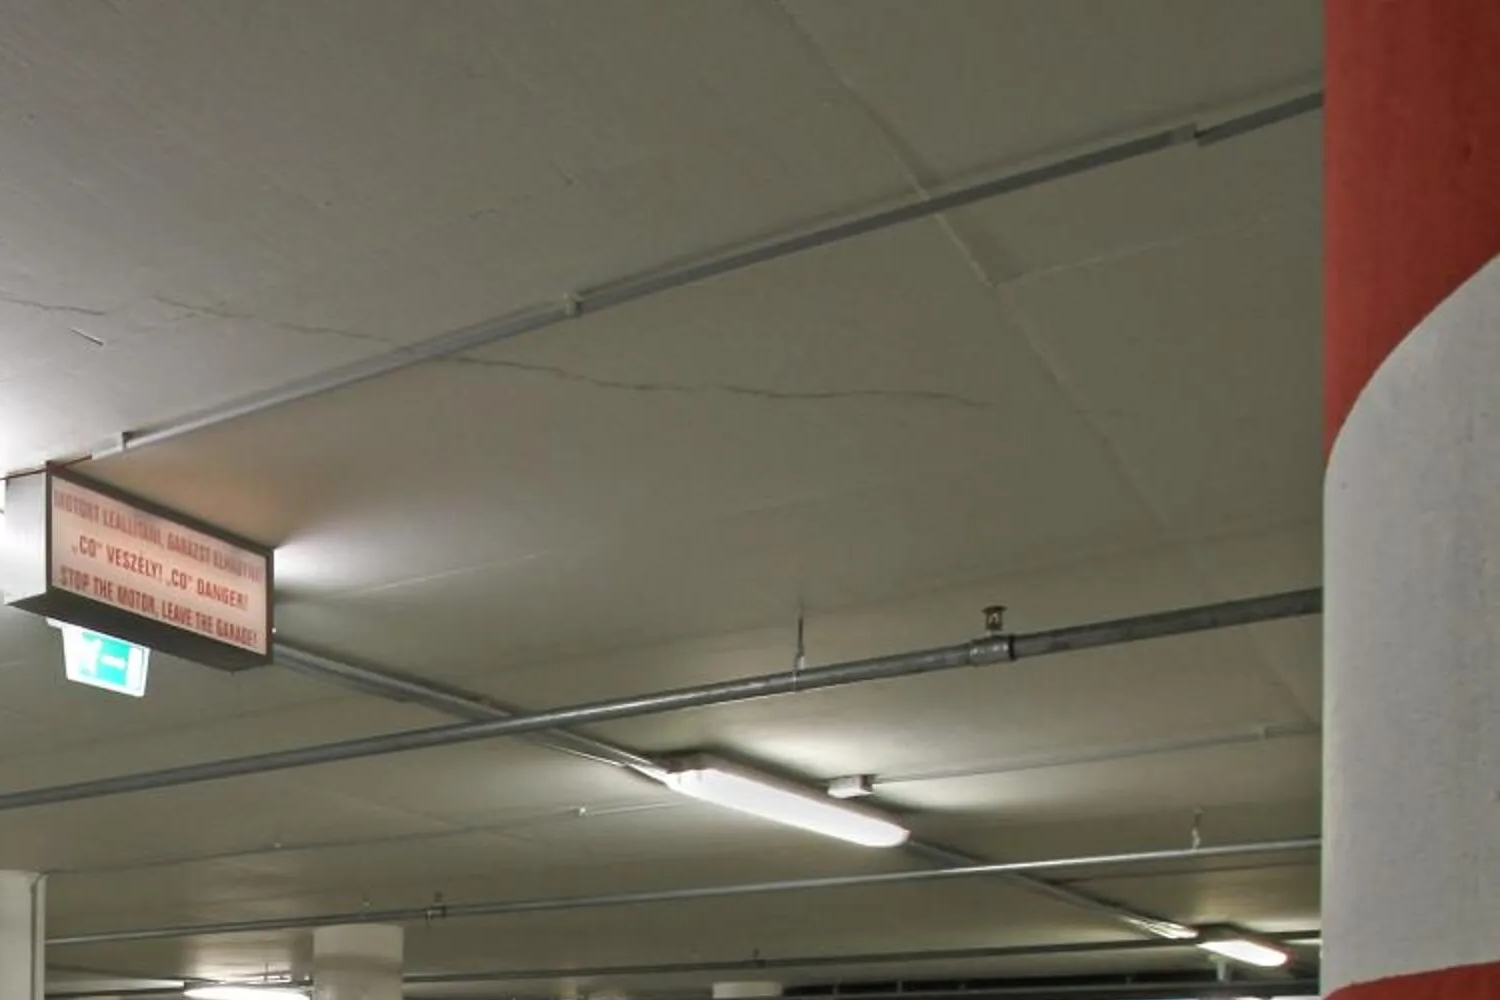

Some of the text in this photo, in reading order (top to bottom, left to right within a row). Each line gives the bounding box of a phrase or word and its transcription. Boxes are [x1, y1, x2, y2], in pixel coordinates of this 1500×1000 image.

[60, 564, 89, 592] STOP
[93, 575, 113, 601] THE
[162, 599, 192, 627] LEAVE
[195, 612, 213, 634] THE
